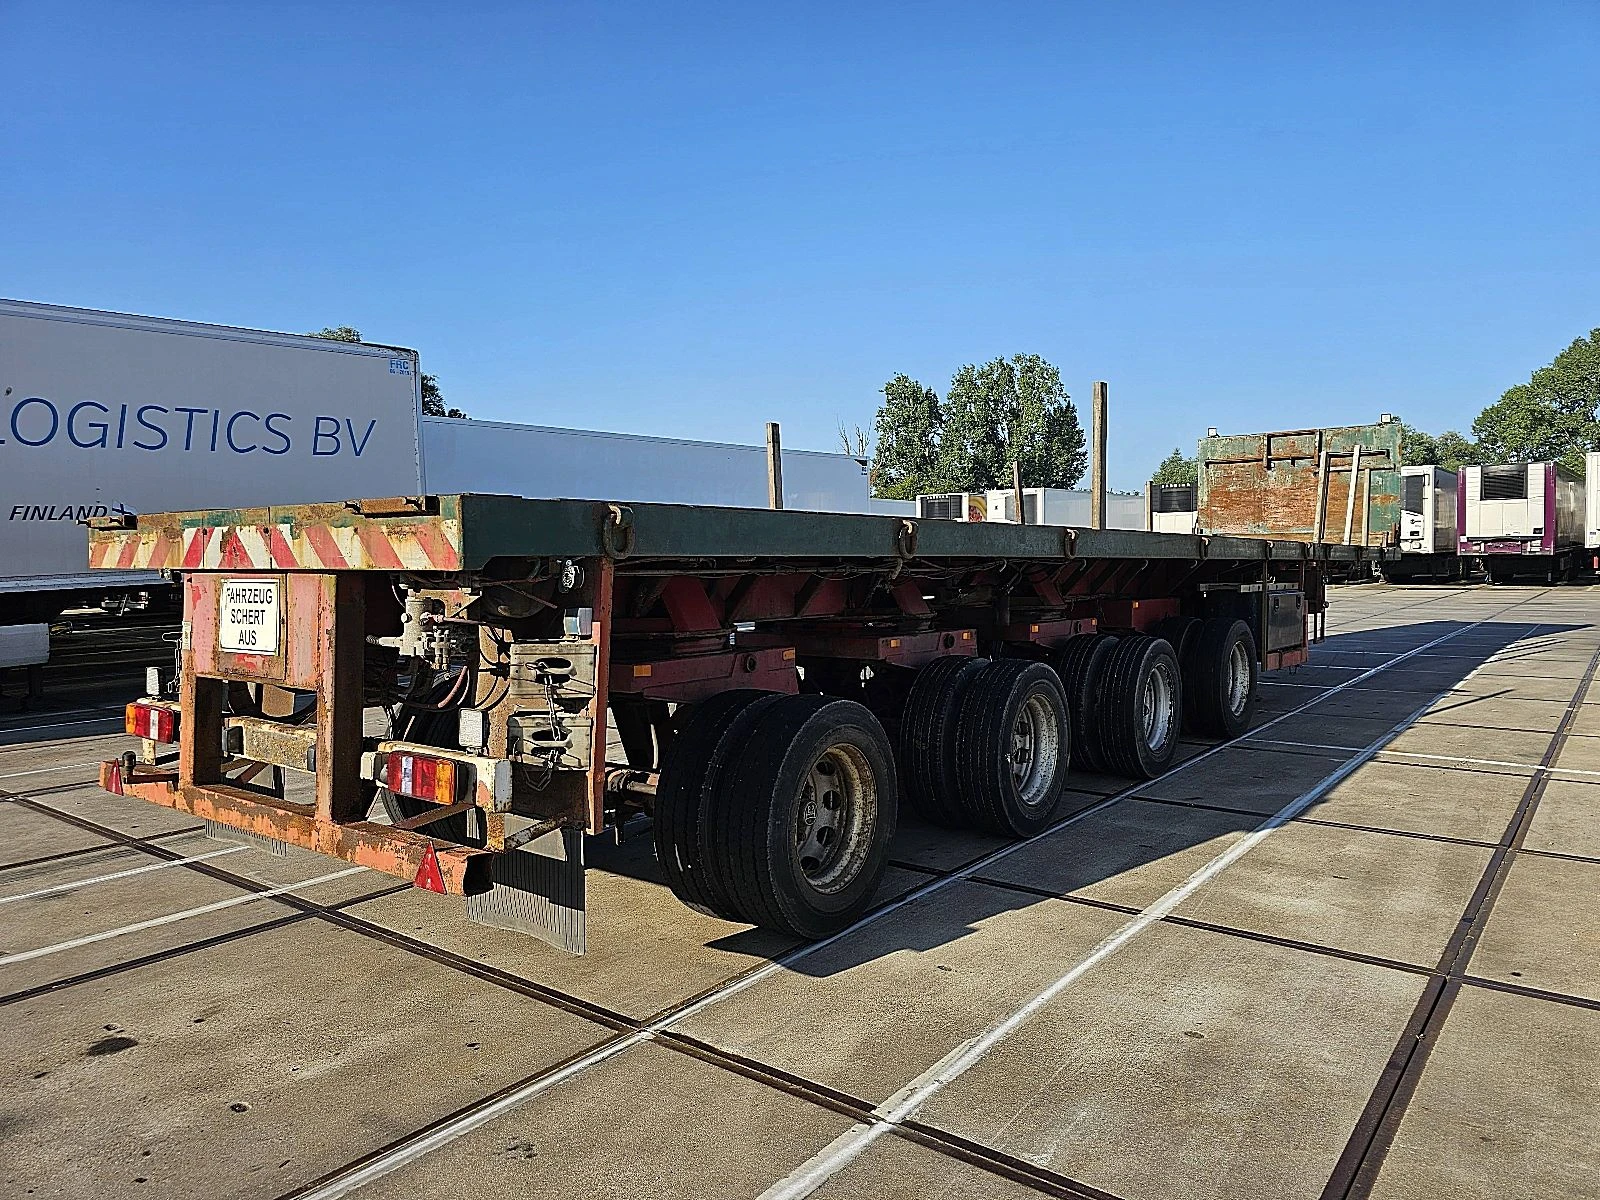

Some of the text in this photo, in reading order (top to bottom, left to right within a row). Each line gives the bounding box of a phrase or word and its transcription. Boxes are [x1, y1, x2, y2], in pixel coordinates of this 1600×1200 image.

[390, 360, 409, 369] FRC
[0, 397, 377, 457] OGISTICS BV
[8, 505, 108, 521] FINLAND
[226, 587, 273, 604] FAHRZEUG
[230, 608, 265, 625] SCHERT
[238, 629, 257, 645] AUS
